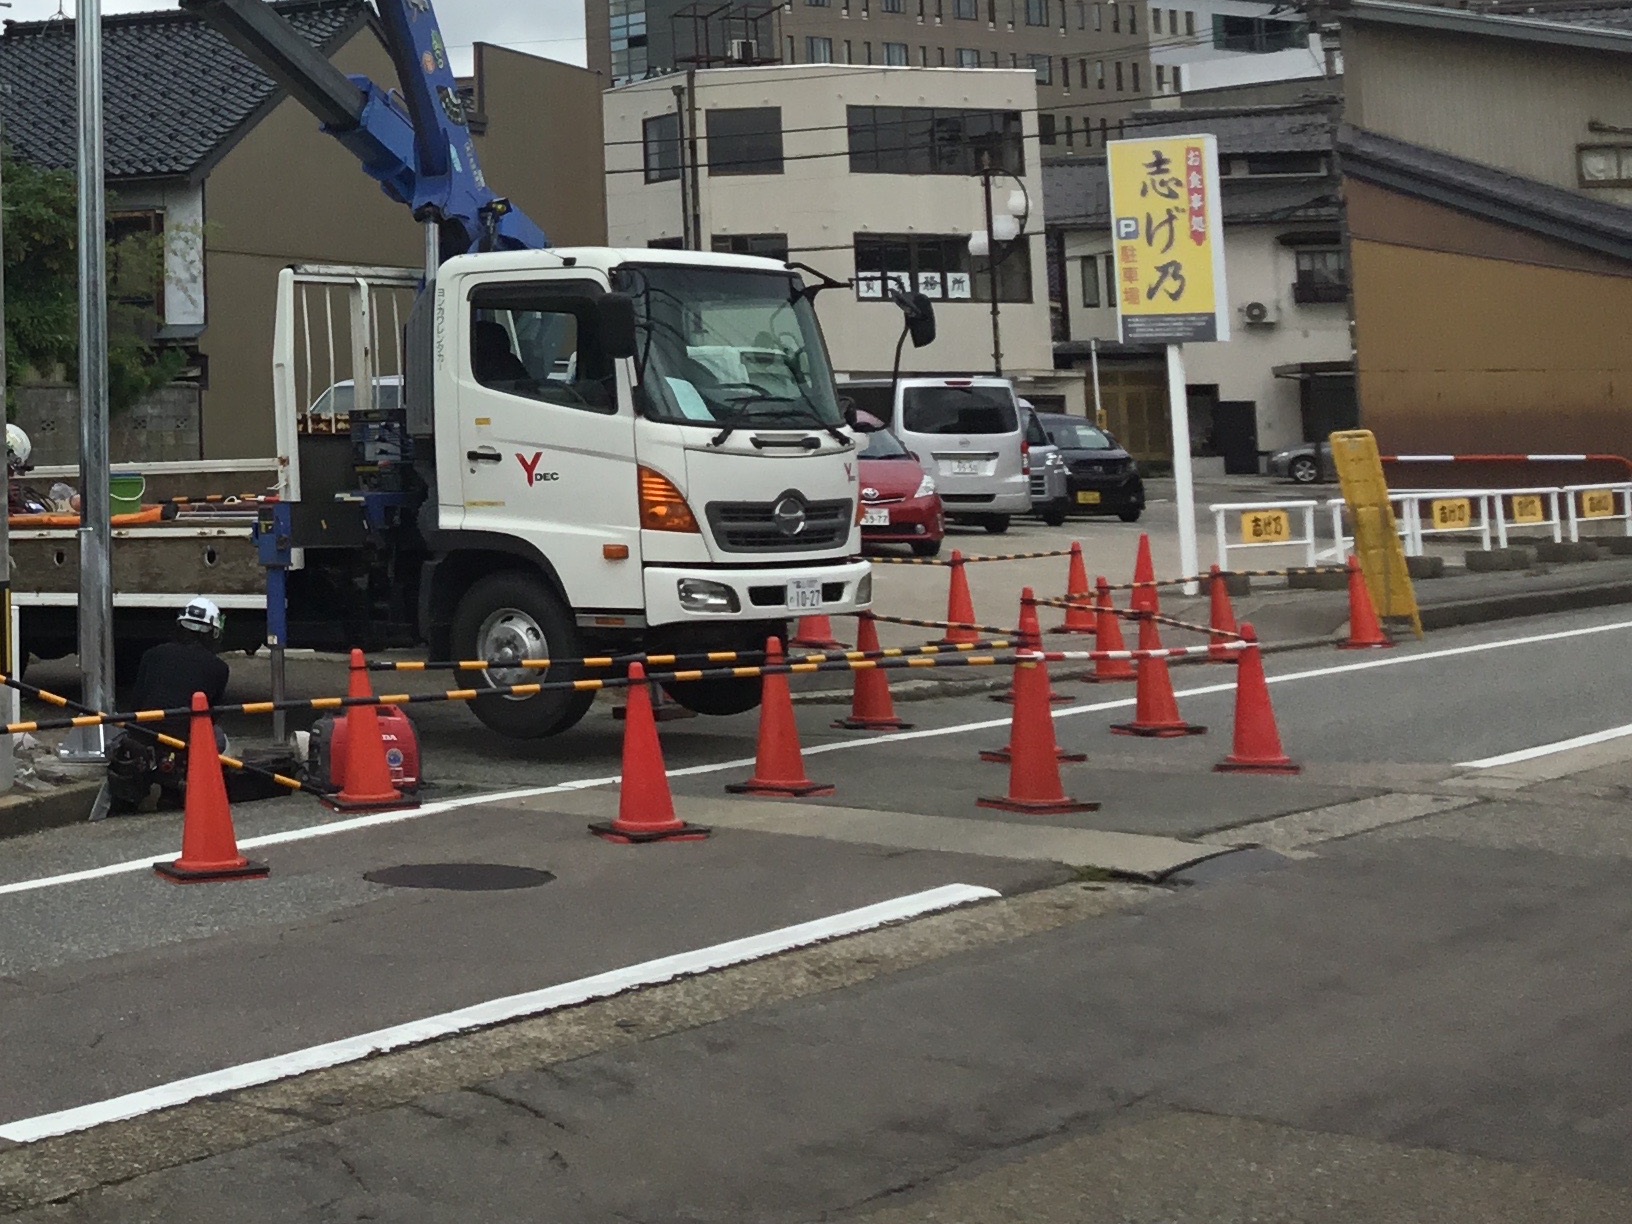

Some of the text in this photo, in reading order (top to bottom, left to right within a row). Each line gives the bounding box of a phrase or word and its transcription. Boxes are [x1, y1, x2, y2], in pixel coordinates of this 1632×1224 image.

[1119, 220, 1137, 238] P
[1140, 150, 1186, 302] 志げ乃
[1120, 244, 1141, 306] 駐車場
